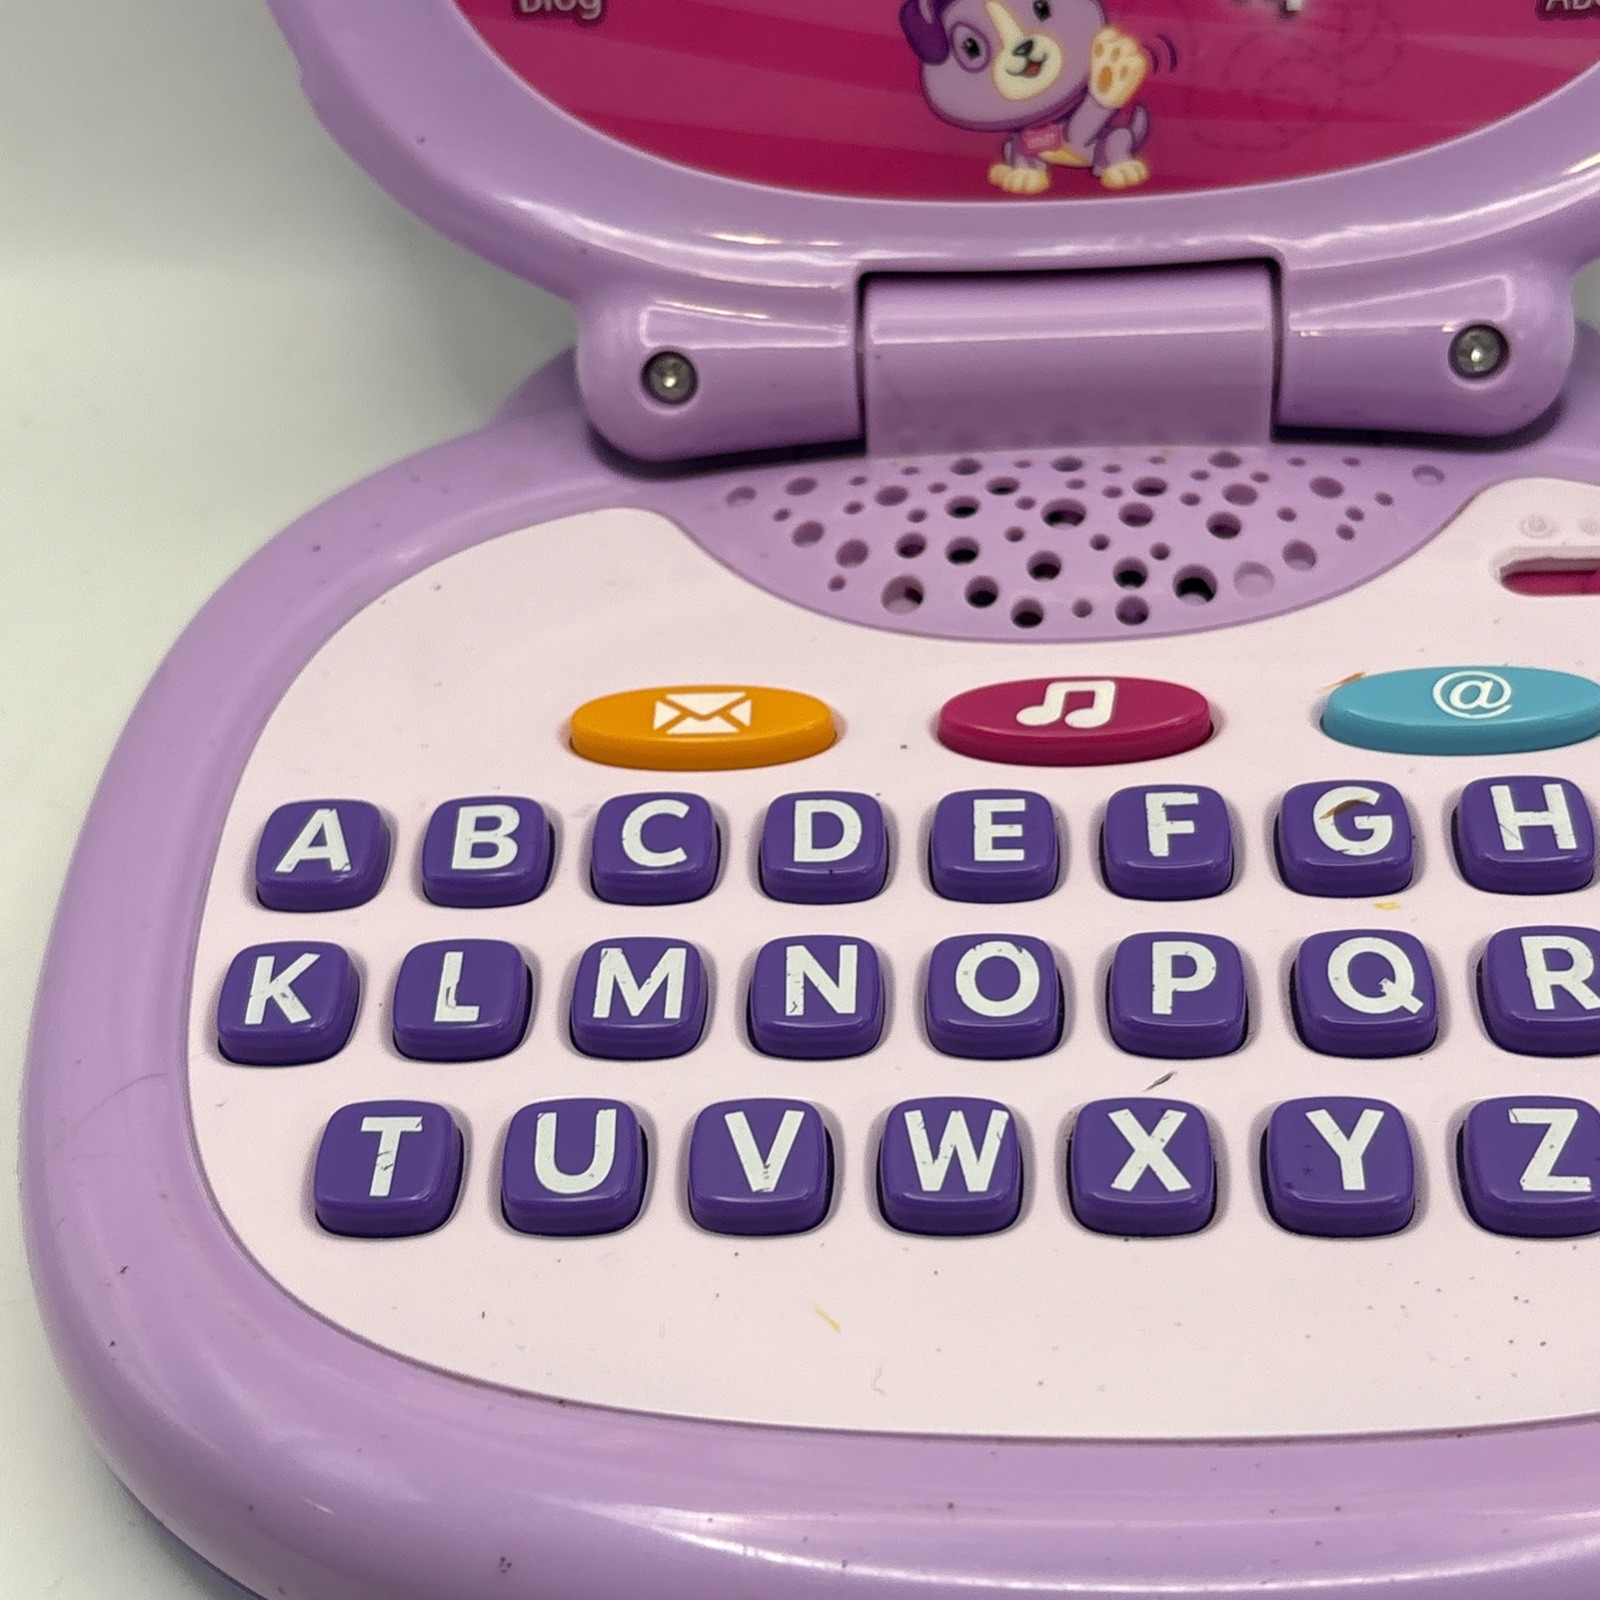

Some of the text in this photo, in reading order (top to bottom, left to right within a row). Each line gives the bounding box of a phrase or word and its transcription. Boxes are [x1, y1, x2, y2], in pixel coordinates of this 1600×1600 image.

[1432, 671, 1512, 718] @
[275, 784, 1578, 872] A B C D E F G H
[245, 936, 1600, 1024] K L M N O P Q R
[361, 1109, 1591, 1196] T U V W X Y Z
